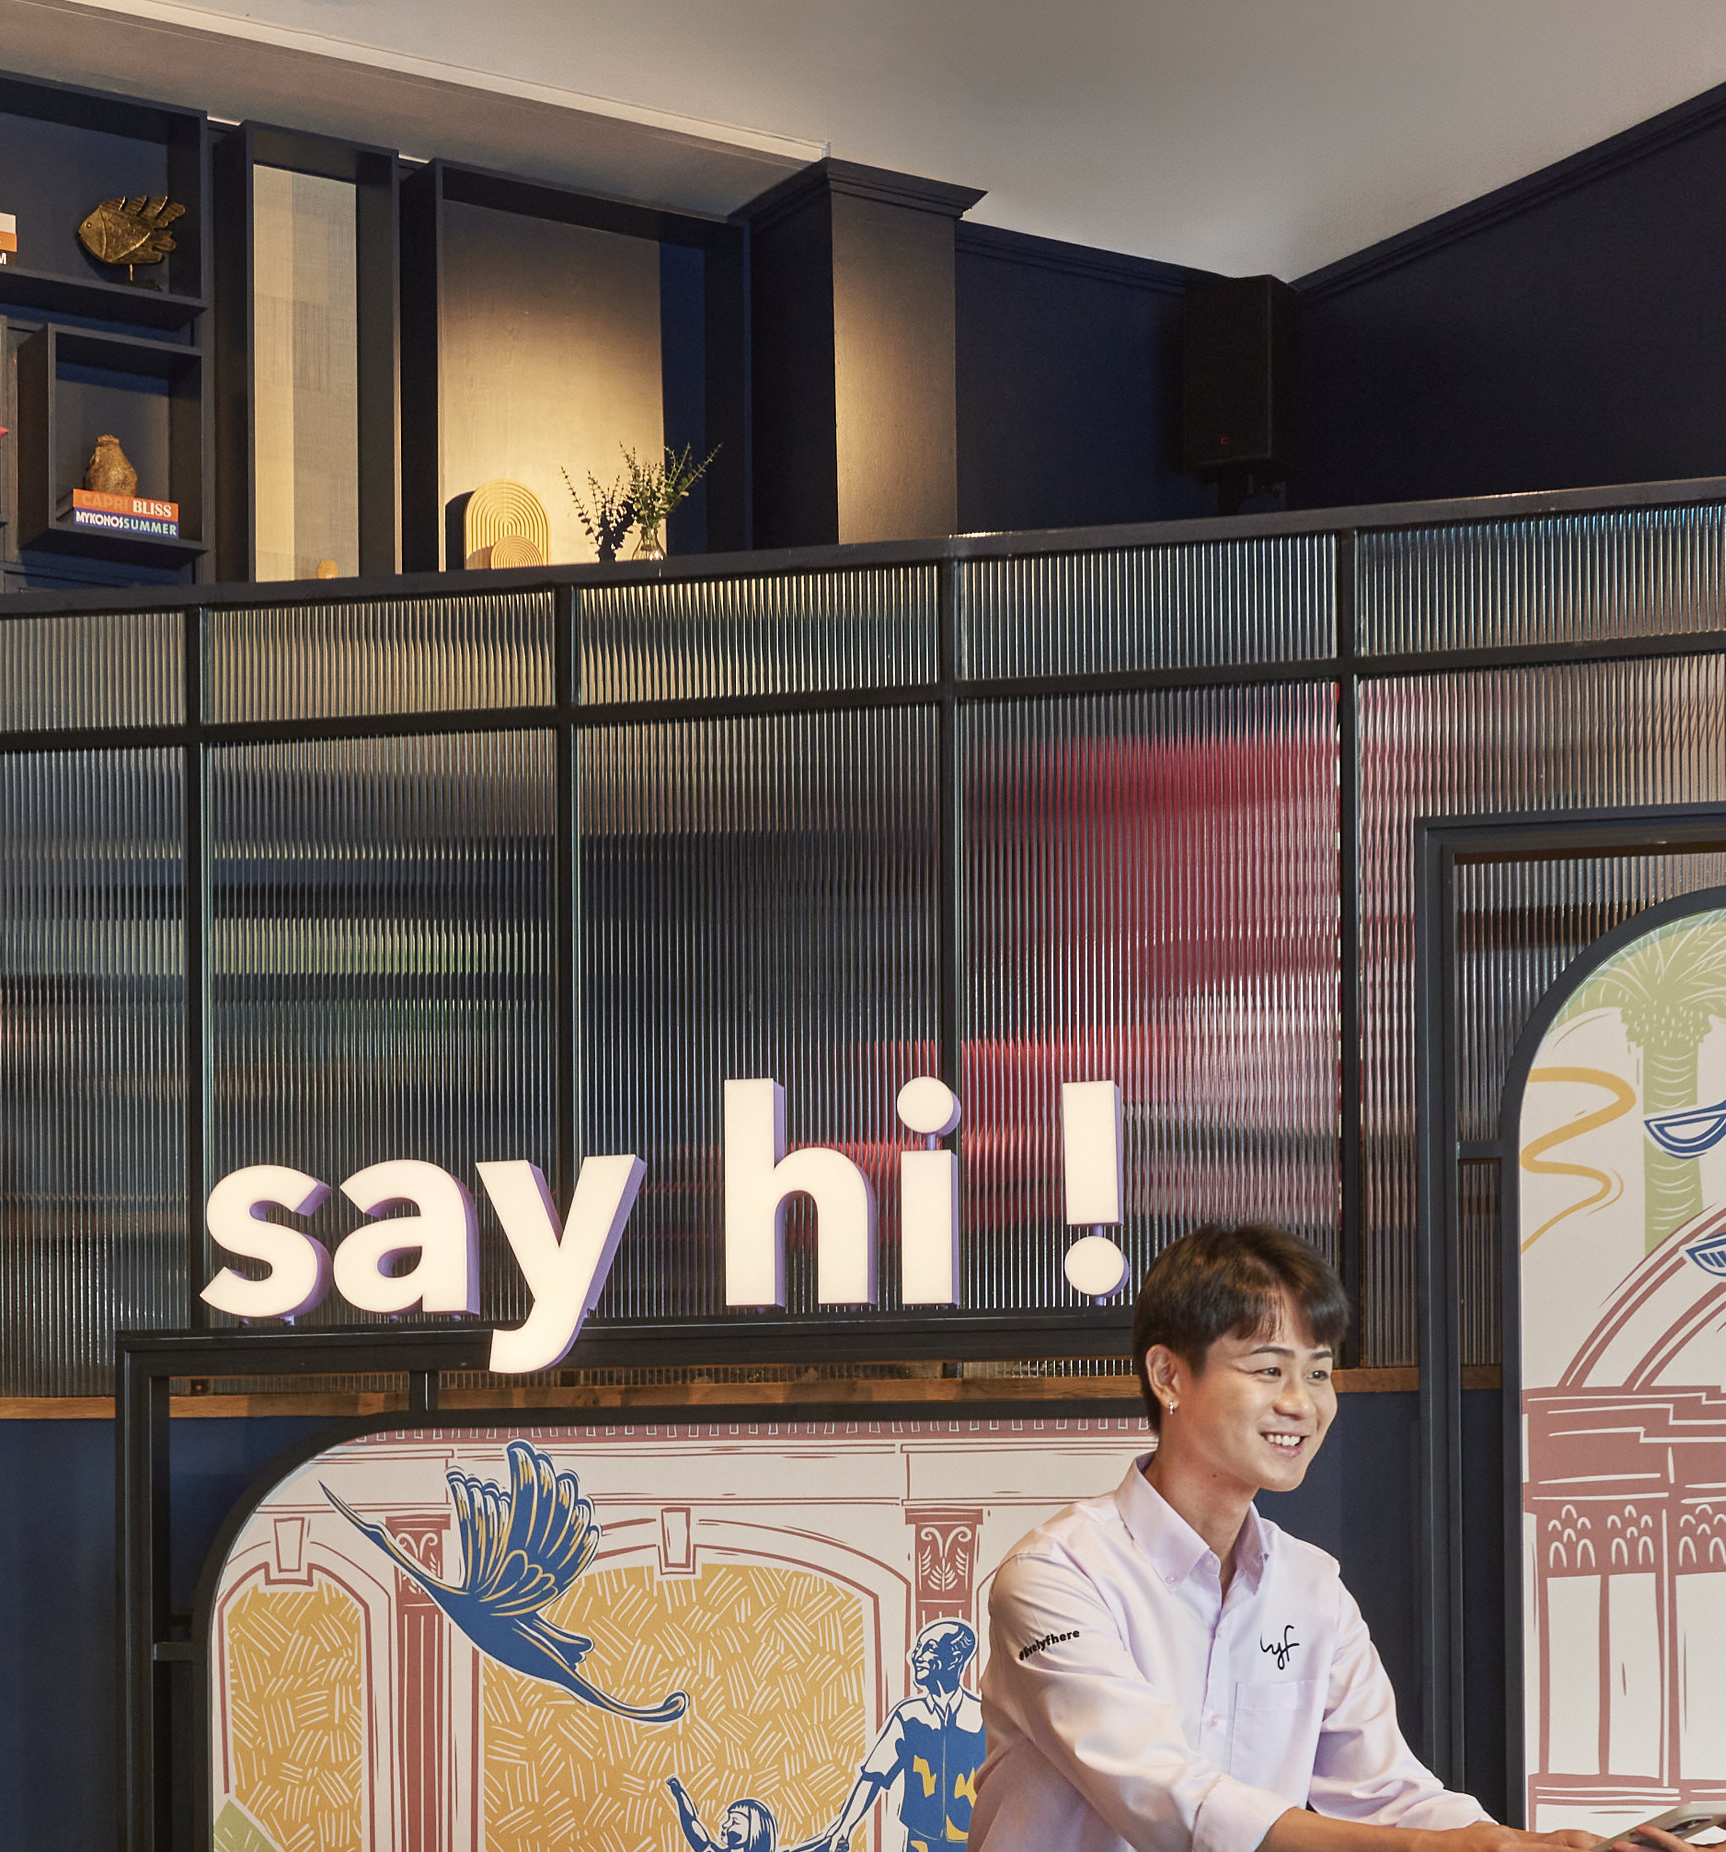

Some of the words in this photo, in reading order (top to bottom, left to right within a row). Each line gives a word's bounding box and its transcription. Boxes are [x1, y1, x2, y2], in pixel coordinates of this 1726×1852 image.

[82, 494, 129, 512] CAPRI
[132, 500, 172, 518] BLISS
[75, 510, 124, 529] MYKONOS
[123, 518, 177, 536] SUMMER
[199, 1154, 648, 1374] say
[723, 1075, 962, 1309] hi
